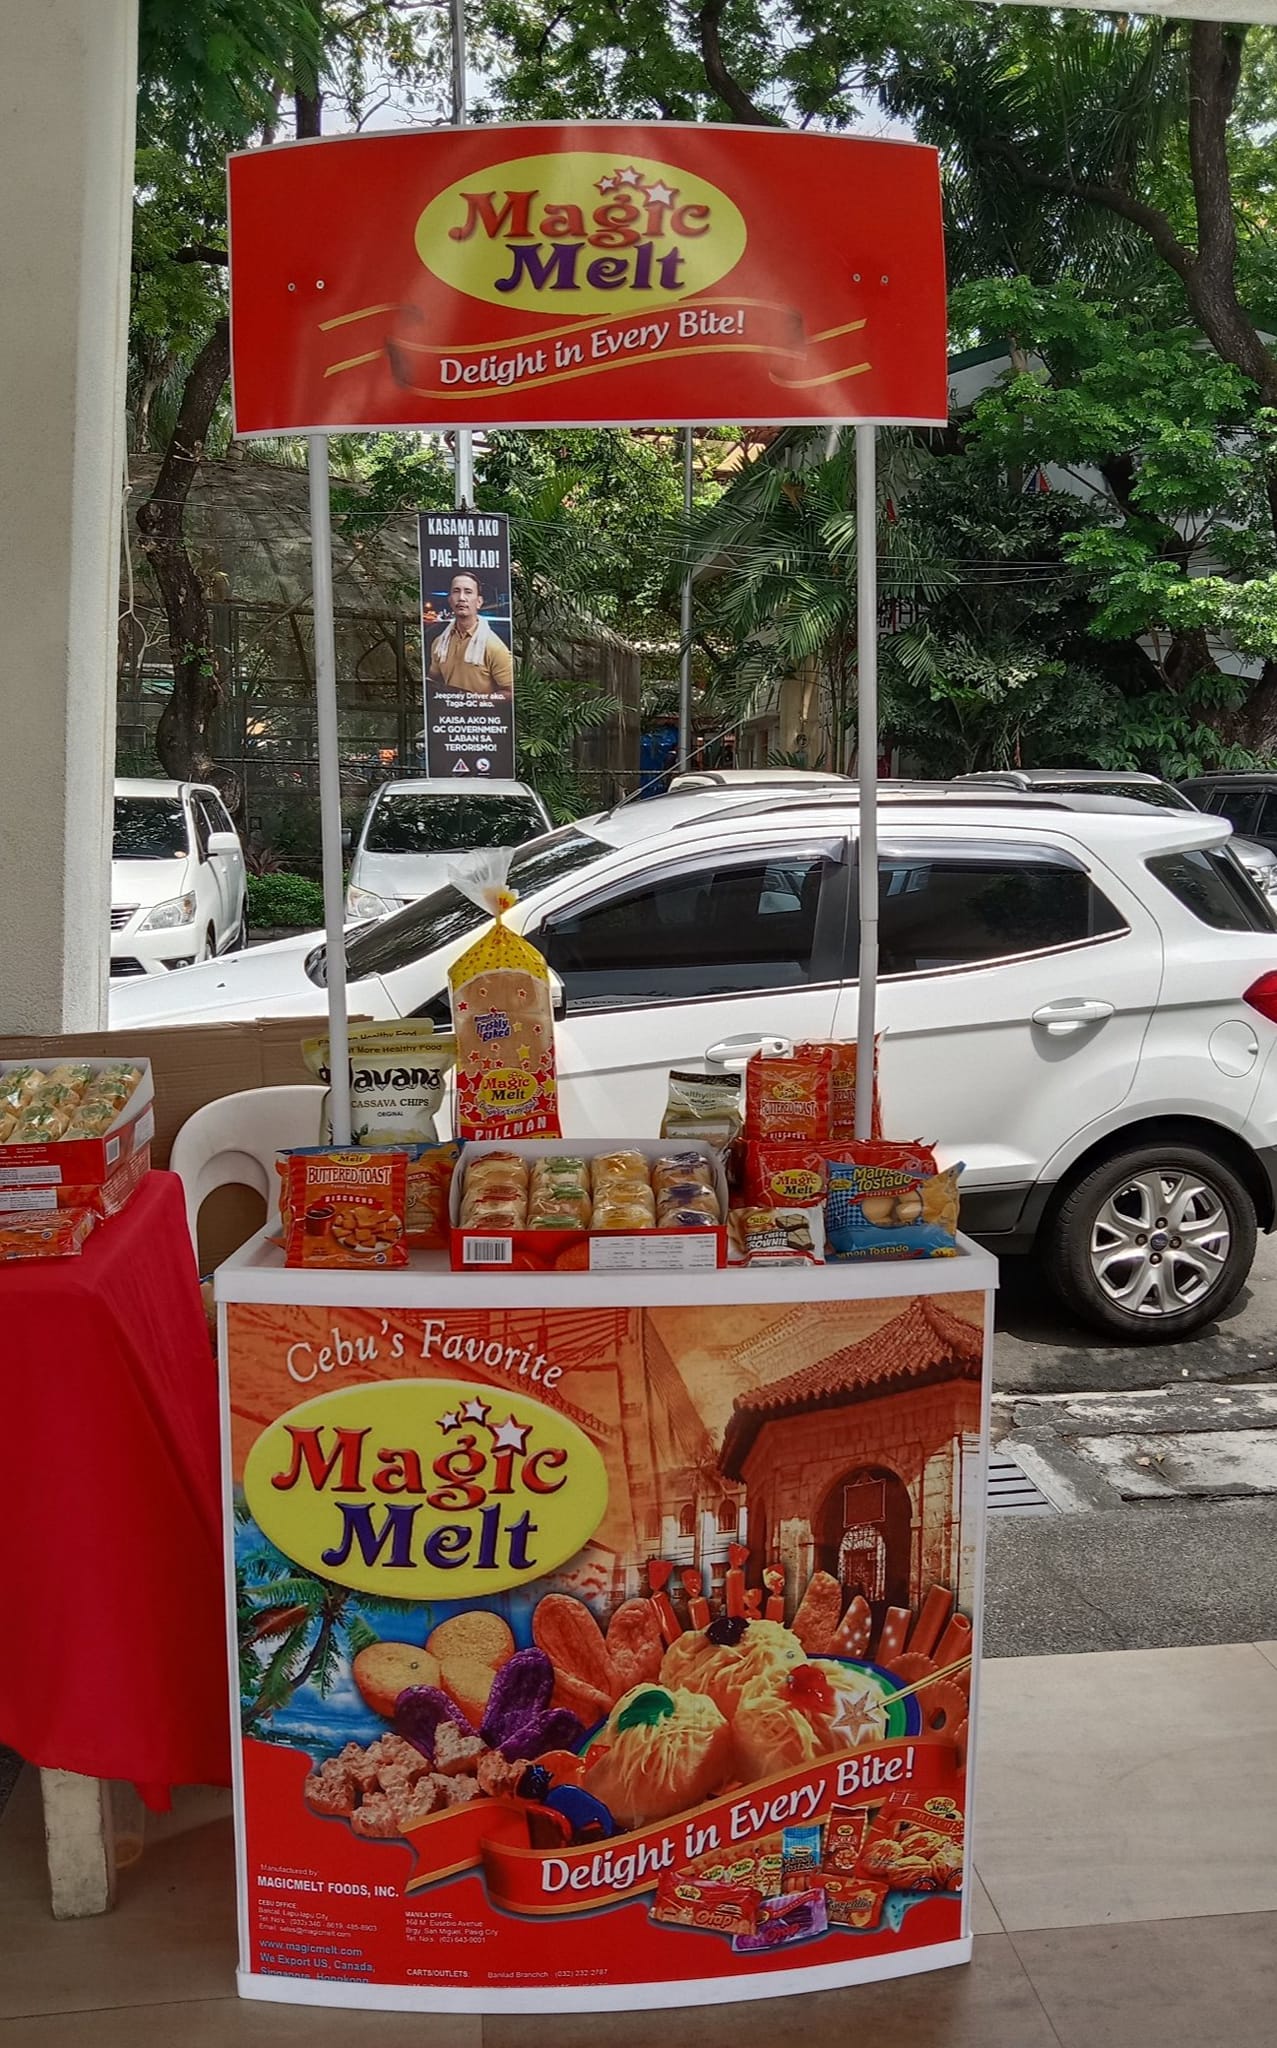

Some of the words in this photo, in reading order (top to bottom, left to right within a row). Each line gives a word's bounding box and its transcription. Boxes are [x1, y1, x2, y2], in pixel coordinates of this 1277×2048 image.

[448, 190, 711, 248] Magic
[494, 242, 685, 292] Melt
[440, 351, 547, 386] Delight
[554, 341, 584, 368] in
[590, 320, 670, 360] Every
[678, 309, 745, 340] Bite!
[428, 518, 475, 537] KASAMA
[477, 519, 499, 537] AKO
[458, 535, 470, 549] SA
[429, 548, 500, 568] PAG-UNLAD!
[434, 692, 465, 700] Jeepney
[466, 692, 488, 700] Driver
[490, 692, 506, 700] ako.
[445, 700, 477, 708] Taga-QC
[439, 716, 466, 724] KAISA
[488, 717, 501, 725] NG
[432, 725, 446, 733] QC
[448, 725, 508, 733] GOVERNMENT
[444, 744, 497, 752] TERORISMO!
[357, 1045, 380, 1054] More
[382, 1043, 417, 1054] Healthy
[420, 1043, 442, 1051] Food
[484, 1076, 530, 1090] Magic
[491, 1089, 526, 1101] Melt
[350, 1100, 397, 1109] CASSAVA
[400, 1099, 430, 1107] CHIPS
[475, 1116, 547, 1140] PULLMAN
[306, 1166, 359, 1184] BUTTERED
[358, 1166, 393, 1184] TOAST
[776, 1175, 817, 1186] Magic
[783, 1185, 812, 1195] Melt
[857, 1175, 913, 1191] Tostado
[869, 1245, 909, 1255] Tostado
[286, 1319, 404, 1383] Cebu's
[421, 1319, 564, 1389] Favorite
[271, 1425, 568, 1511] Magic
[321, 1502, 538, 1569] Melt
[541, 1842, 675, 1893] Delight
[685, 1823, 721, 1856] in
[729, 1780, 826, 1840] Every
[837, 1746, 915, 1797] Bite!
[260, 1864, 307, 1874] Manufactured
[257, 1875, 325, 1892] MAGICMELT
[328, 1883, 372, 1898] FOODS,
[374, 1886, 399, 1897] INC.
[696, 1912, 734, 1927] Otap
[259, 1940, 363, 1956] www.magicmelt.com
[260, 1952, 275, 1963] We
[277, 1954, 311, 1966] Export
